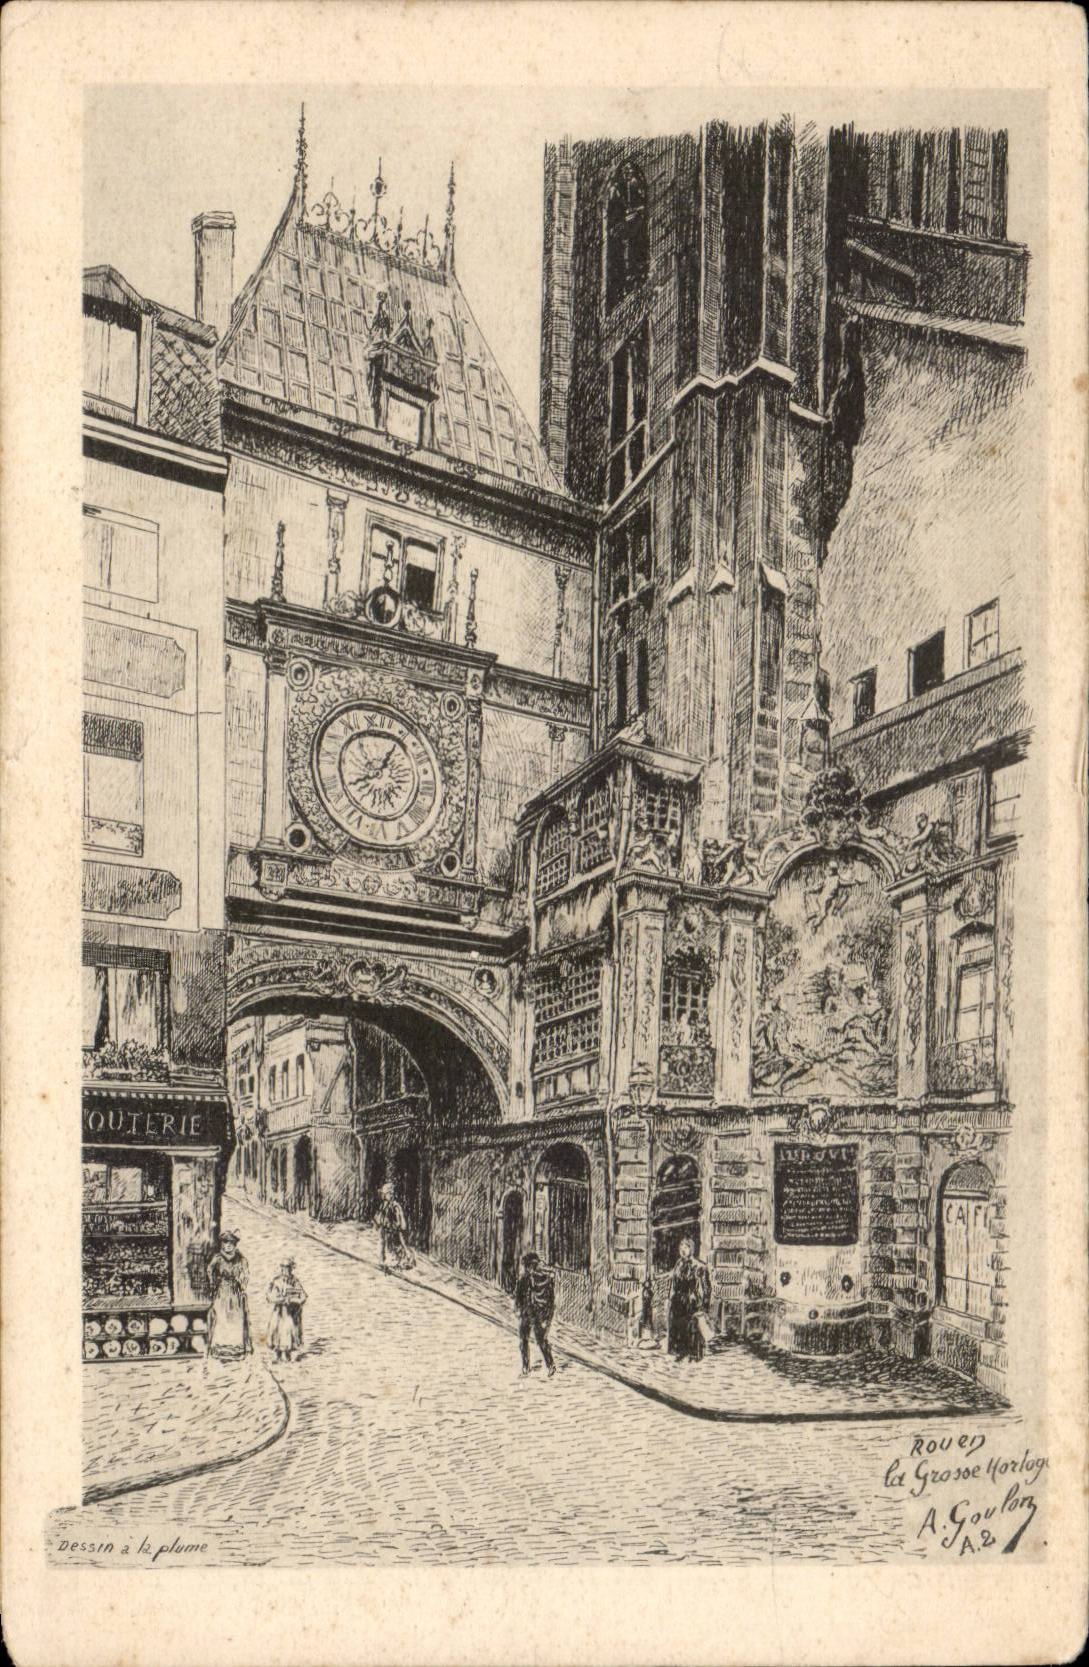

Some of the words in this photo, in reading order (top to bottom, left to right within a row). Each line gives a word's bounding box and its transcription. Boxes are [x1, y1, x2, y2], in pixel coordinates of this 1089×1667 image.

[84, 1108, 201, 1136] OUTERIE
[909, 1459, 981, 1498] Grosse
[137, 1536, 151, 1554] la
[152, 1536, 209, 1562] plume
